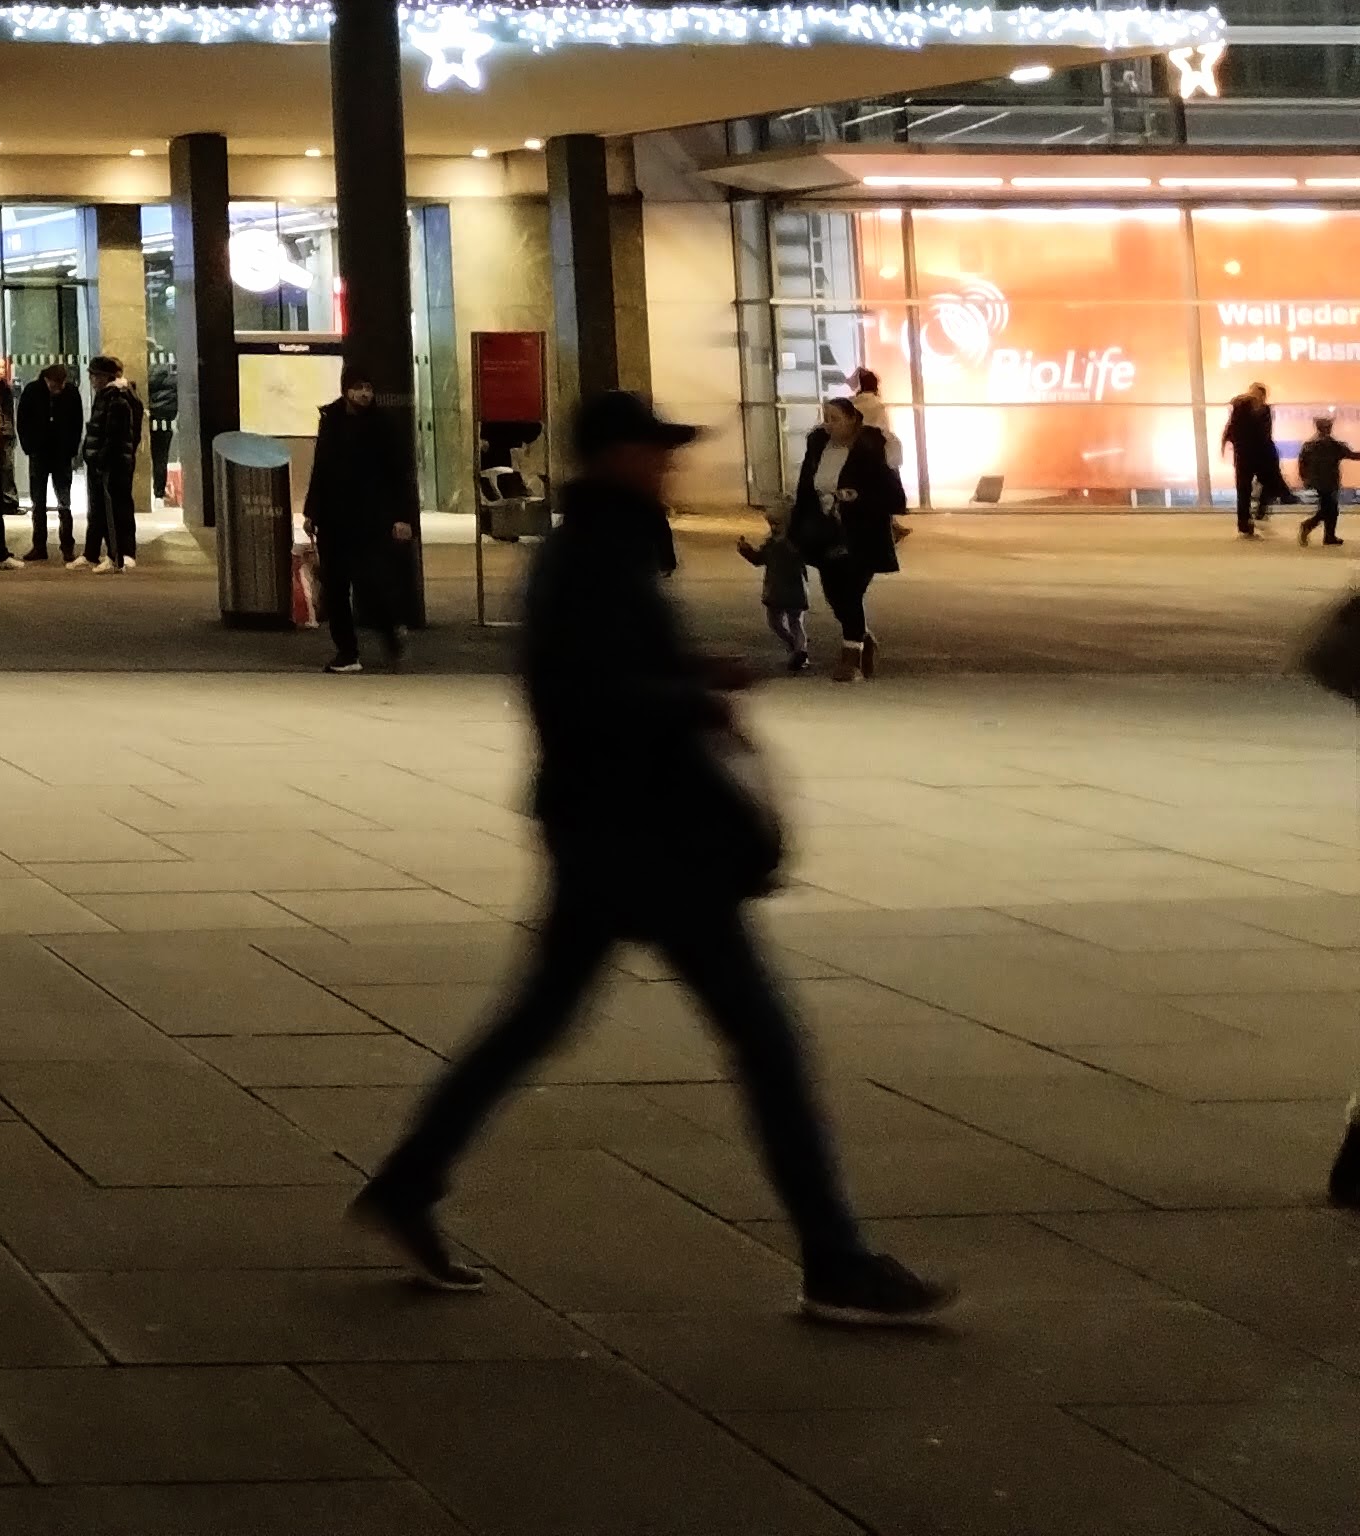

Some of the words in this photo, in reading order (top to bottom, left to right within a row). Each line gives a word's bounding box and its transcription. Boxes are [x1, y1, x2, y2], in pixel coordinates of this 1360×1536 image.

[1217, 303, 1281, 326] Weil
[1219, 335, 1283, 369] jede
[989, 345, 1136, 401] BioLife
